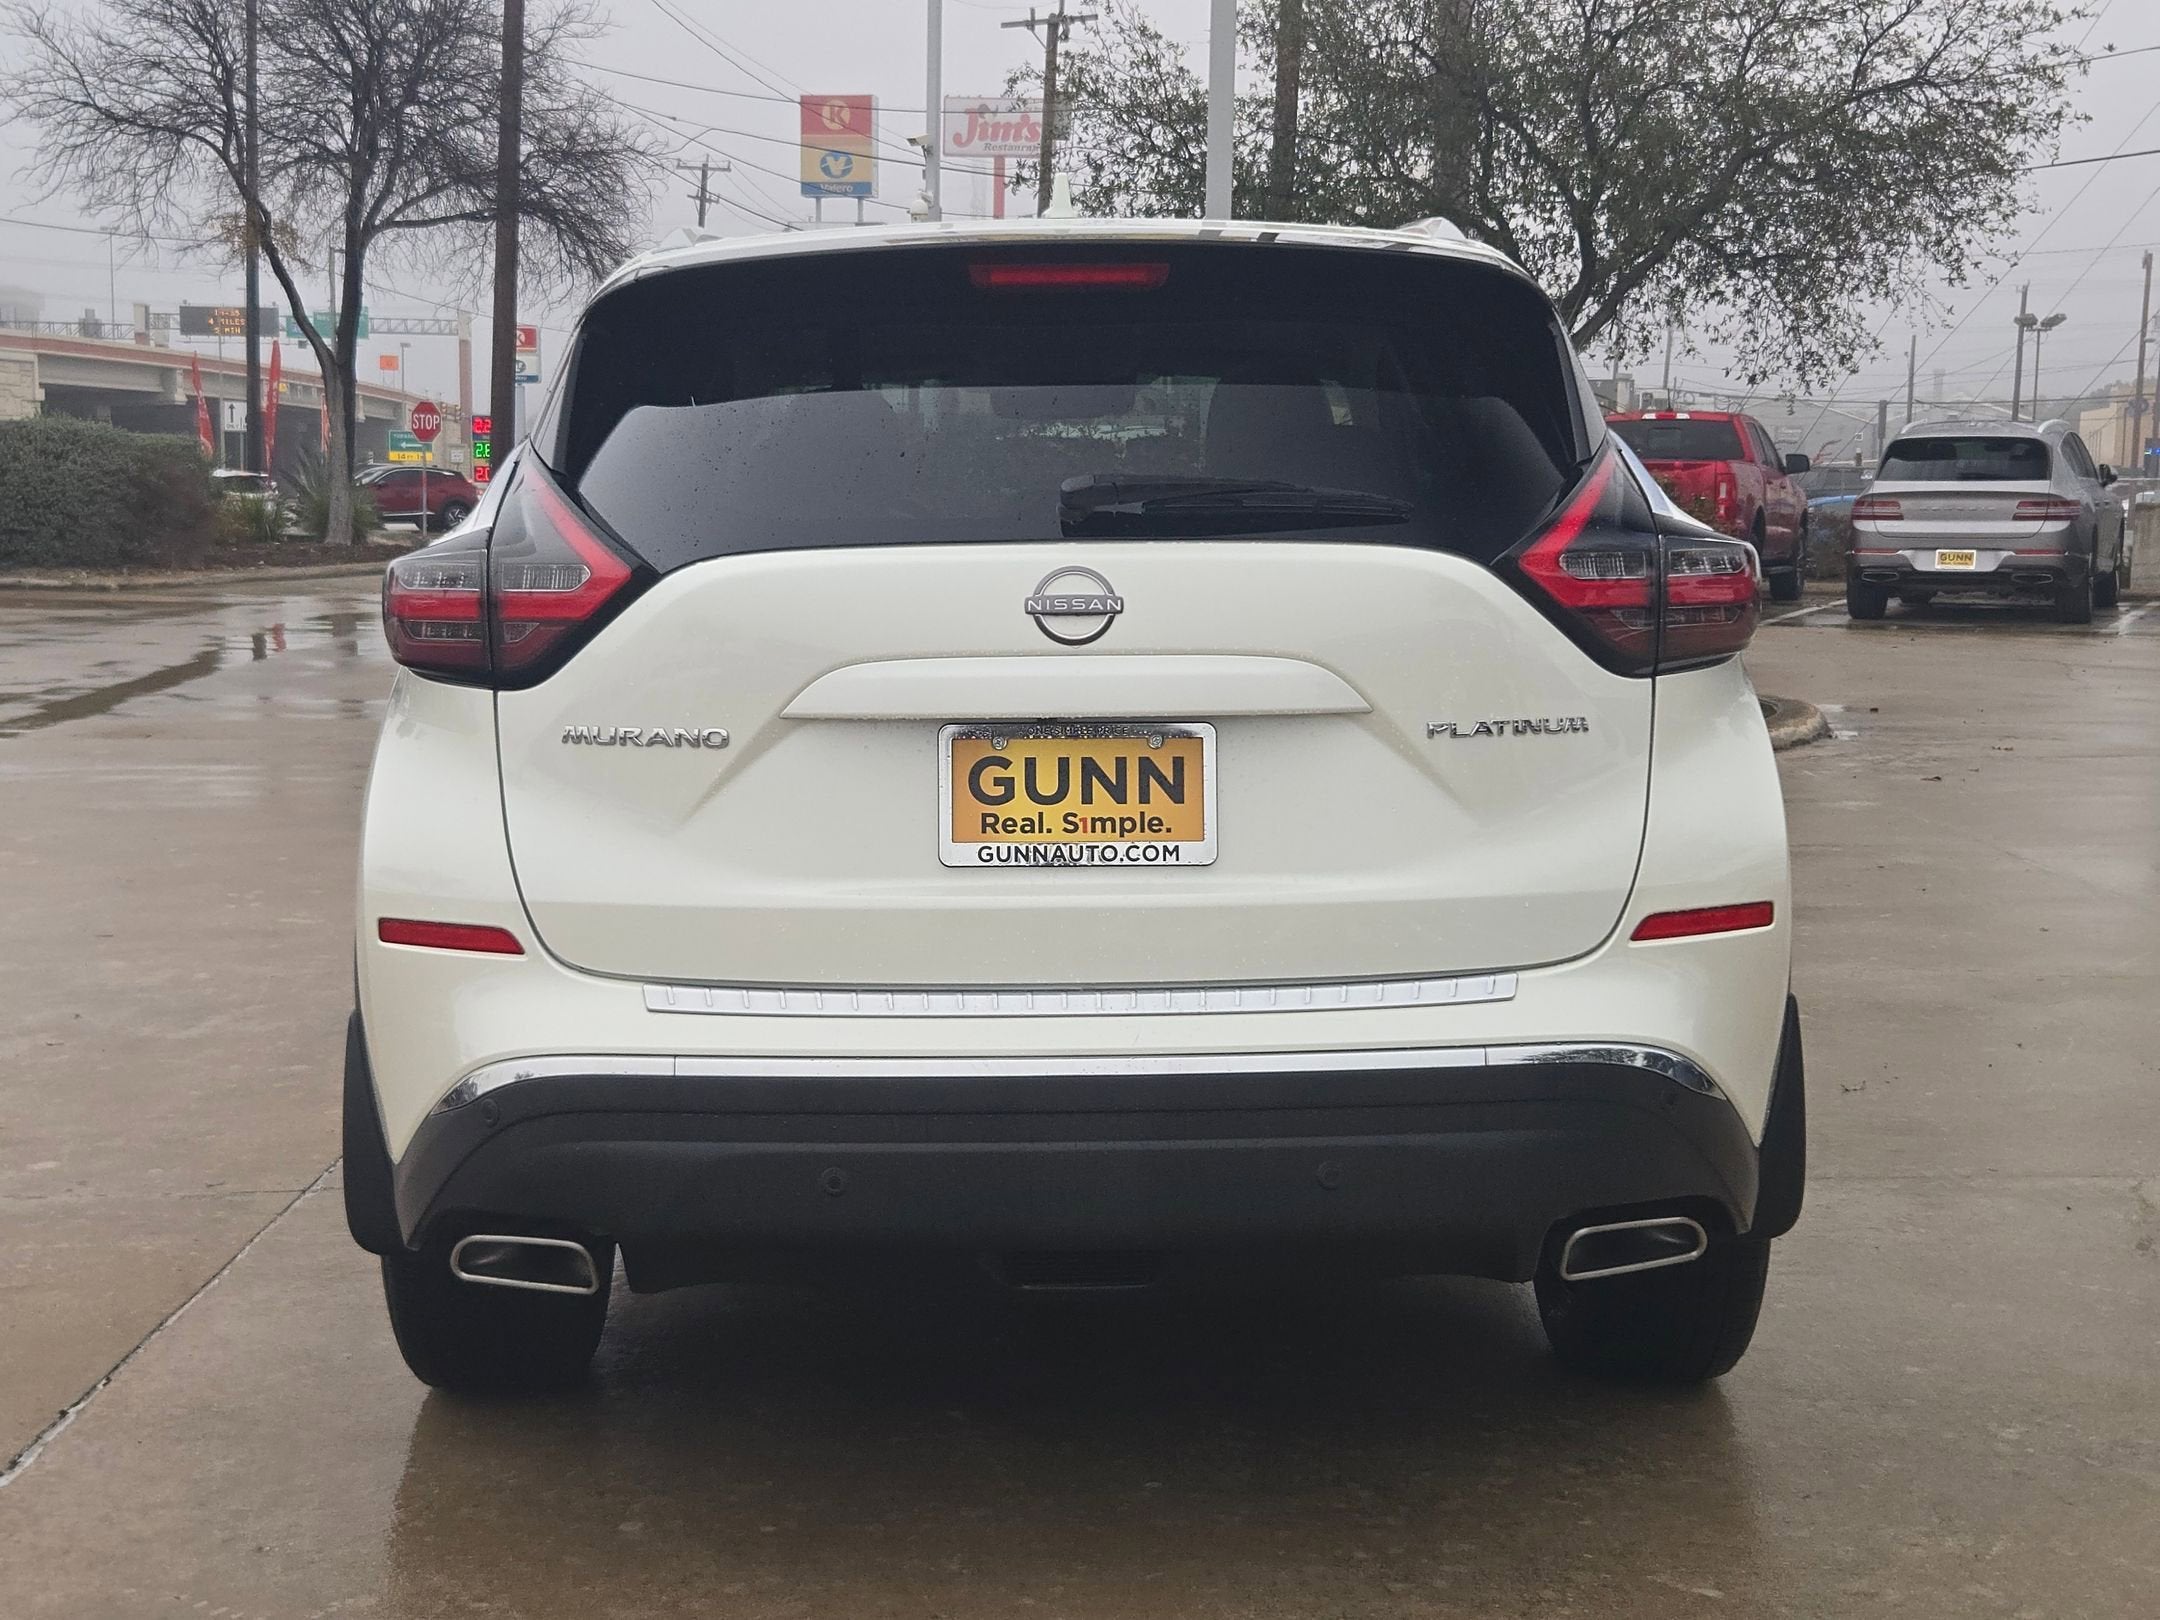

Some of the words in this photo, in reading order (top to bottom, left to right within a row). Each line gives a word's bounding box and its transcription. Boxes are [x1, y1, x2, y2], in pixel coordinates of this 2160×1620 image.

[953, 108, 1041, 148] Jim's
[412, 414, 440, 430] STOP
[1940, 553, 1972, 561] GUNN
[1028, 598, 1121, 611] NISSAN
[561, 725, 730, 750] MURANO
[1427, 717, 1589, 739] PLATINUM
[968, 756, 1185, 806] GUNN
[980, 812, 1052, 834] Real.
[977, 844, 1180, 863] GUNNAUTO.COM
